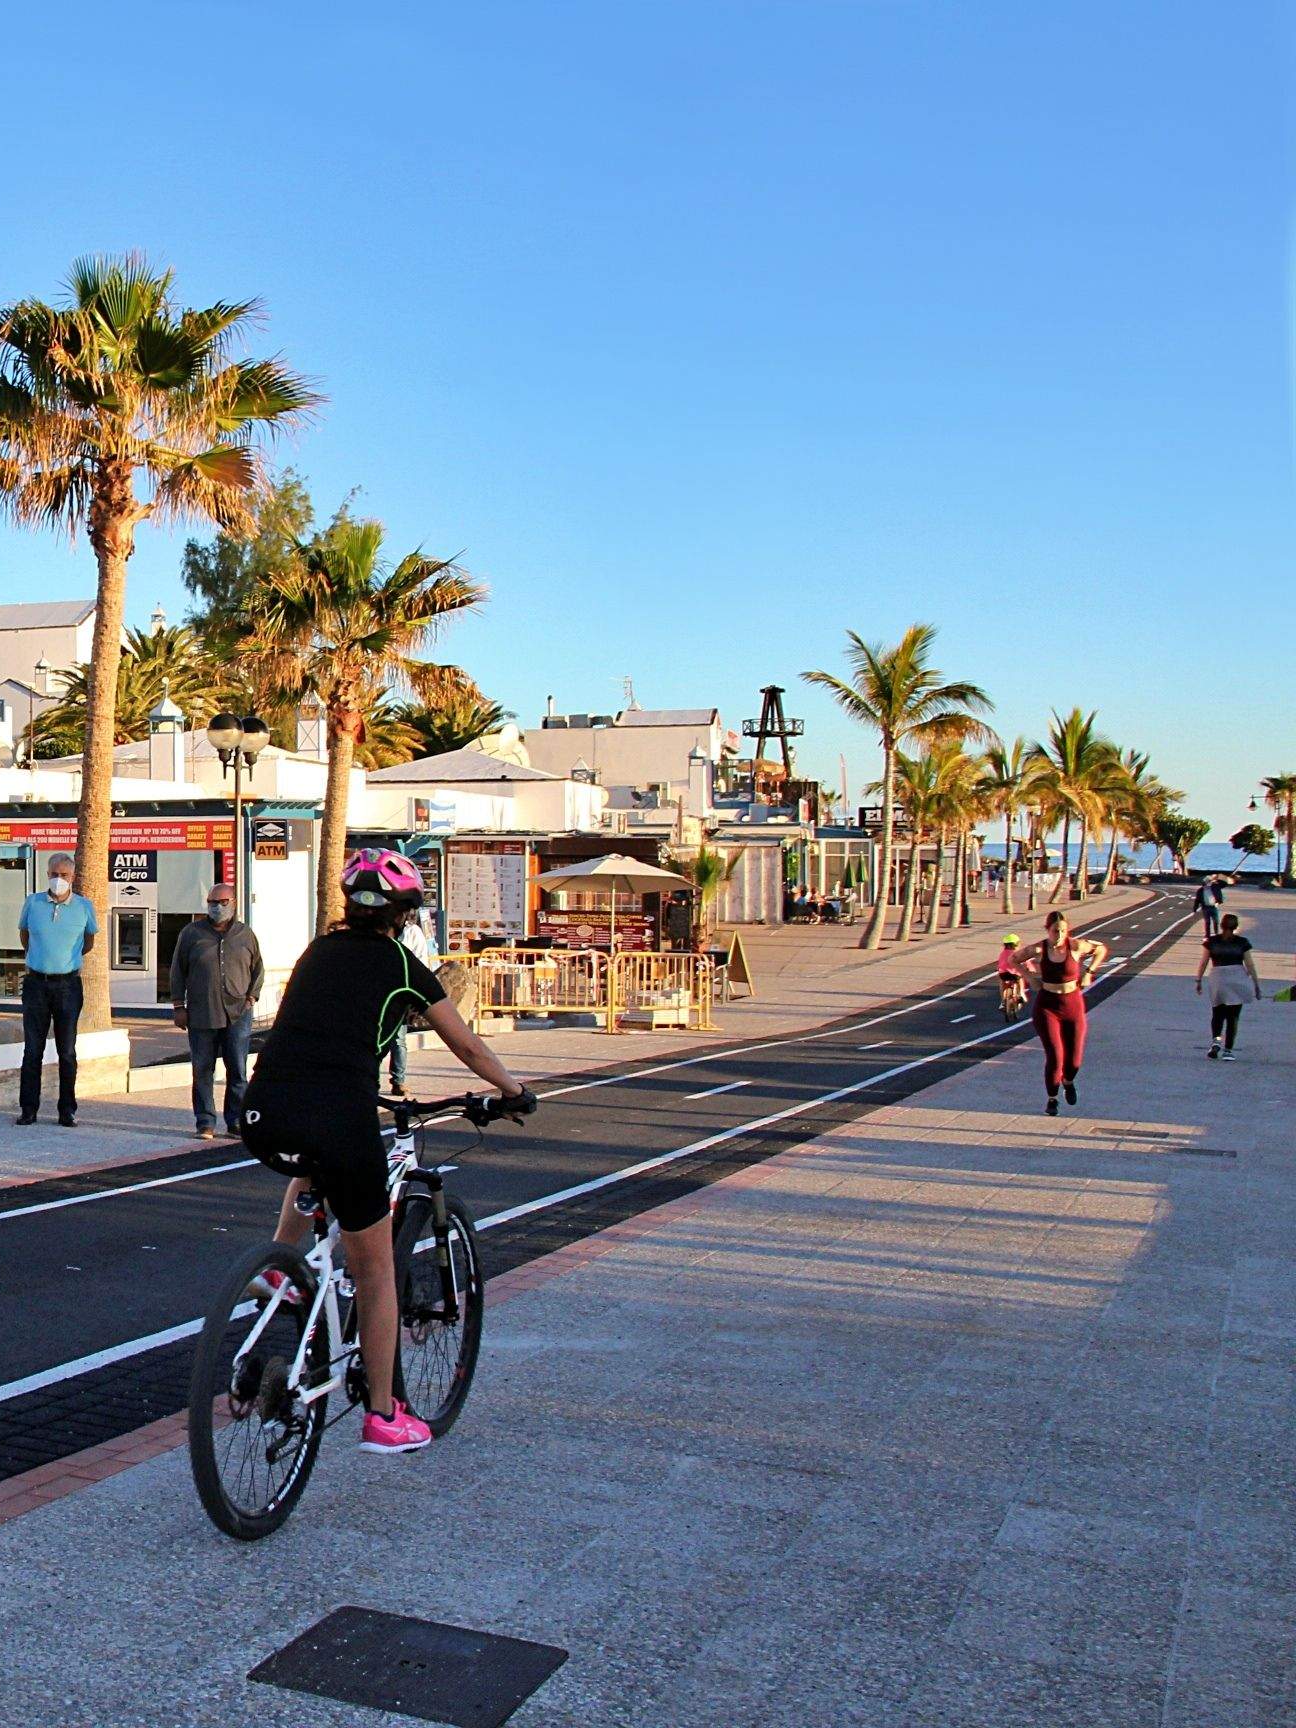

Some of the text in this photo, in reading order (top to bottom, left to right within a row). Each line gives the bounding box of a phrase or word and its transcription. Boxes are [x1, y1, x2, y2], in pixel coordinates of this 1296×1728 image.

[257, 845, 286, 856] ATM
[114, 854, 147, 867] ATM
[113, 868, 148, 881] Cajero
